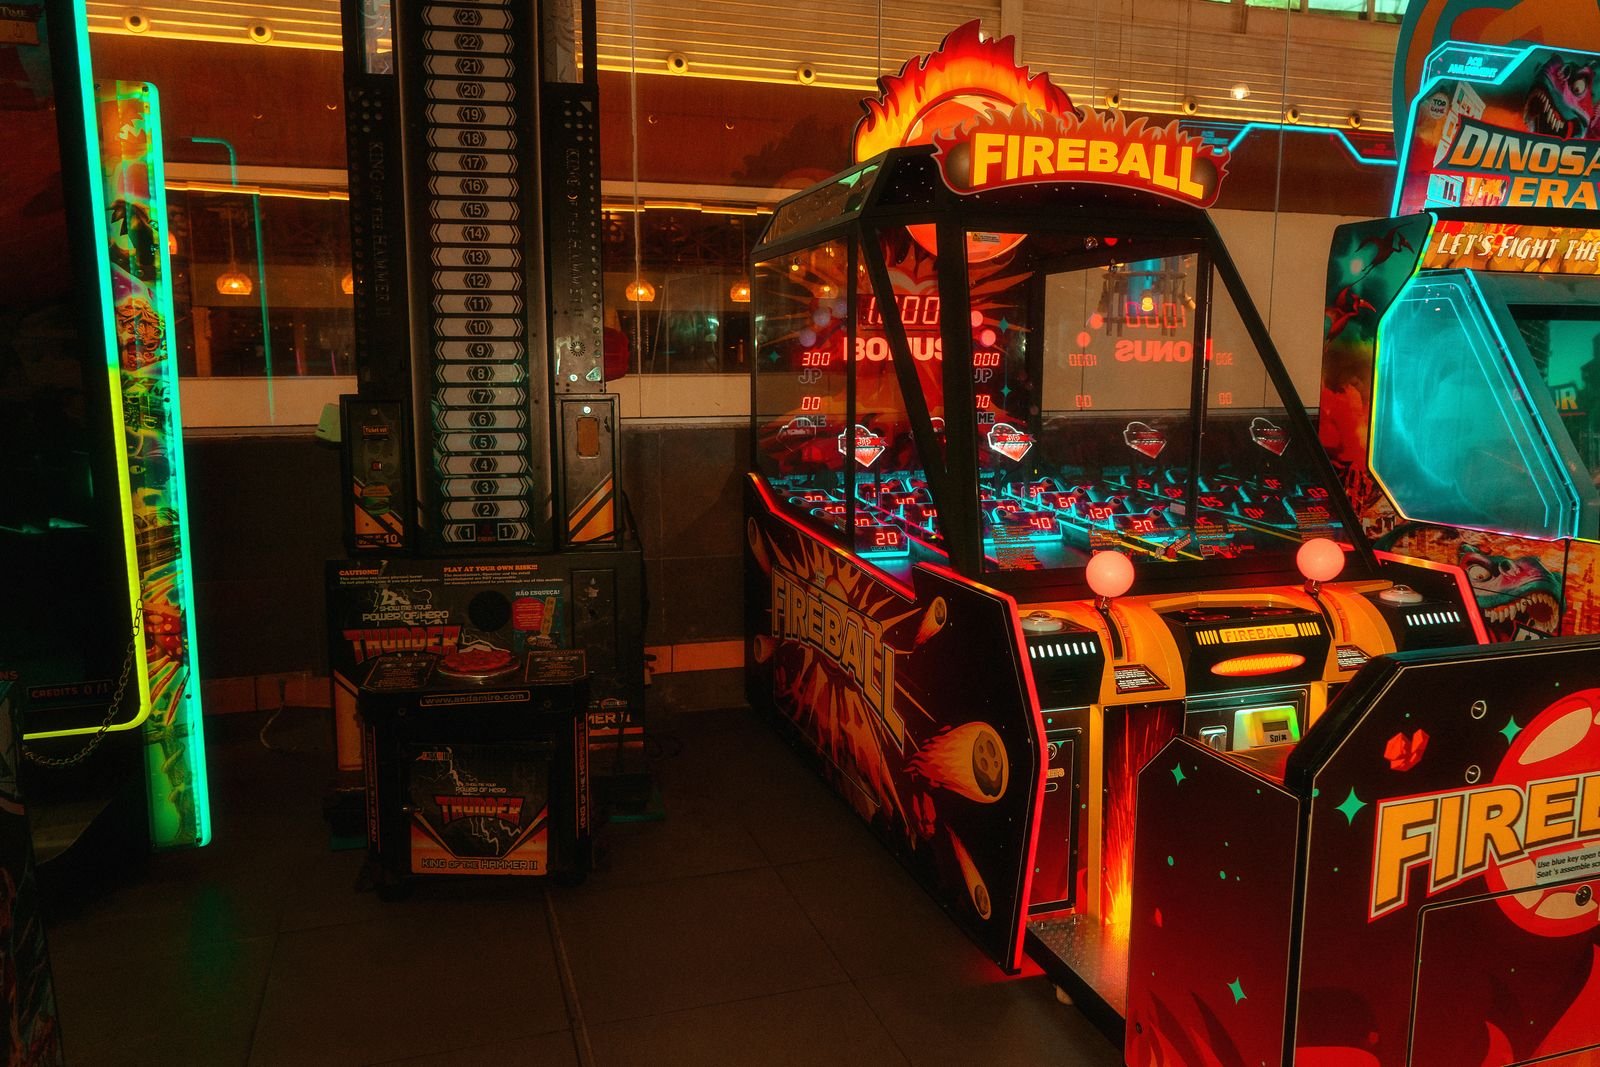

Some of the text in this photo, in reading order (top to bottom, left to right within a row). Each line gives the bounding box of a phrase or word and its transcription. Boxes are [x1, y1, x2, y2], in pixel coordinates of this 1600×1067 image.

[460, 12, 476, 23] 23
[462, 36, 477, 48] 22
[463, 61, 477, 72] 21
[463, 86, 478, 97] 20
[464, 109, 479, 120] 19
[465, 133, 480, 144] 18
[466, 157, 481, 168] 17
[973, 132, 1204, 200] FIREBALL
[467, 181, 481, 192] 16
[1507, 176, 1598, 210] ERA
[467, 205, 482, 216] 15
[468, 228, 482, 239] 14
[1436, 232, 1600, 262] LET'S FIGHT THE
[469, 252, 483, 262] 13
[470, 275, 484, 286] 12
[472, 300, 485, 310] 11
[473, 323, 486, 333] 10
[477, 346, 484, 356] 9
[844, 337, 943, 360] BOU
[802, 352, 830, 366] 300
[478, 368, 485, 378] 8
[799, 368, 822, 384] JP
[974, 368, 993, 383] JP
[479, 392, 485, 402] 7
[802, 397, 820, 410] 00
[479, 415, 486, 425] 6
[480, 437, 487, 447] 5
[480, 460, 488, 470] 4
[481, 482, 489, 492] 3
[482, 505, 490, 515] 2
[1030, 518, 1052, 529] 40
[464, 528, 470, 538] 1
[502, 526, 508, 537] 1
[384, 534, 398, 544] 10
[876, 532, 898, 546] 20
[1225, 626, 1292, 641] FIREBALL
[772, 569, 904, 758] FIREBALL
[434, 796, 524, 825] THUNDER
[422, 859, 446, 868] KING
[482, 860, 527, 869] HAMMER
[1552, 858, 1566, 866] blue
[1580, 852, 1596, 861] open
[1536, 870, 1552, 878] Seat
